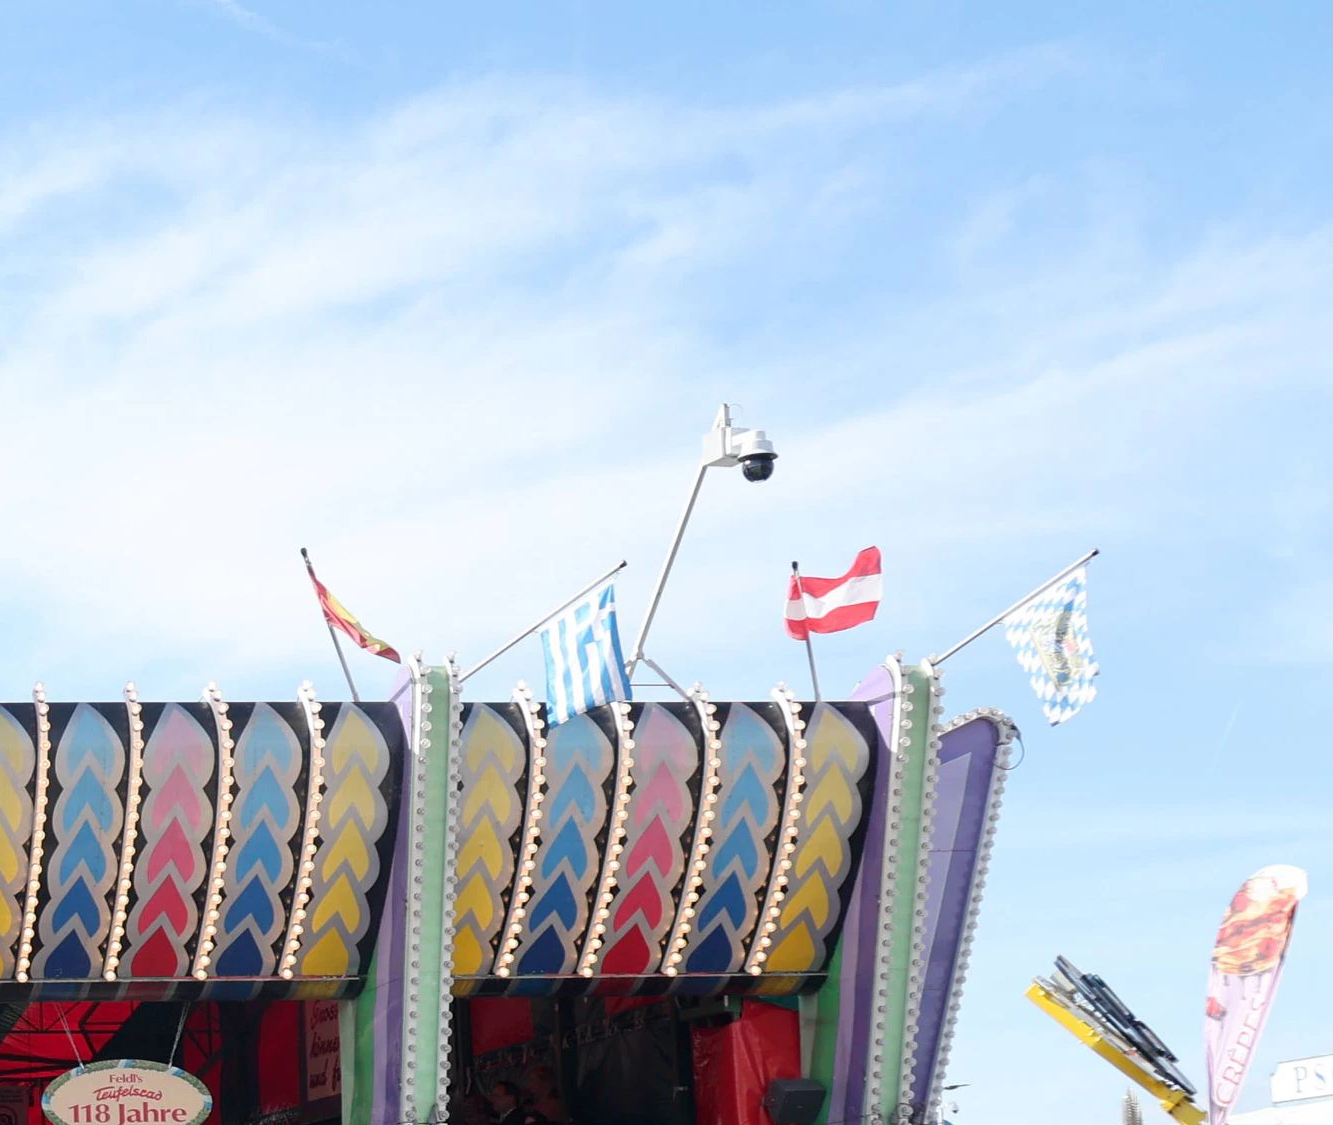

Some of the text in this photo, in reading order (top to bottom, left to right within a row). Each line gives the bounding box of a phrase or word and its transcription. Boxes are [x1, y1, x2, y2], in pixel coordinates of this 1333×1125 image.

[109, 1073, 143, 1084] Feldl's
[93, 1085, 163, 1102] Teufelsrad
[69, 1103, 111, 1124] 118
